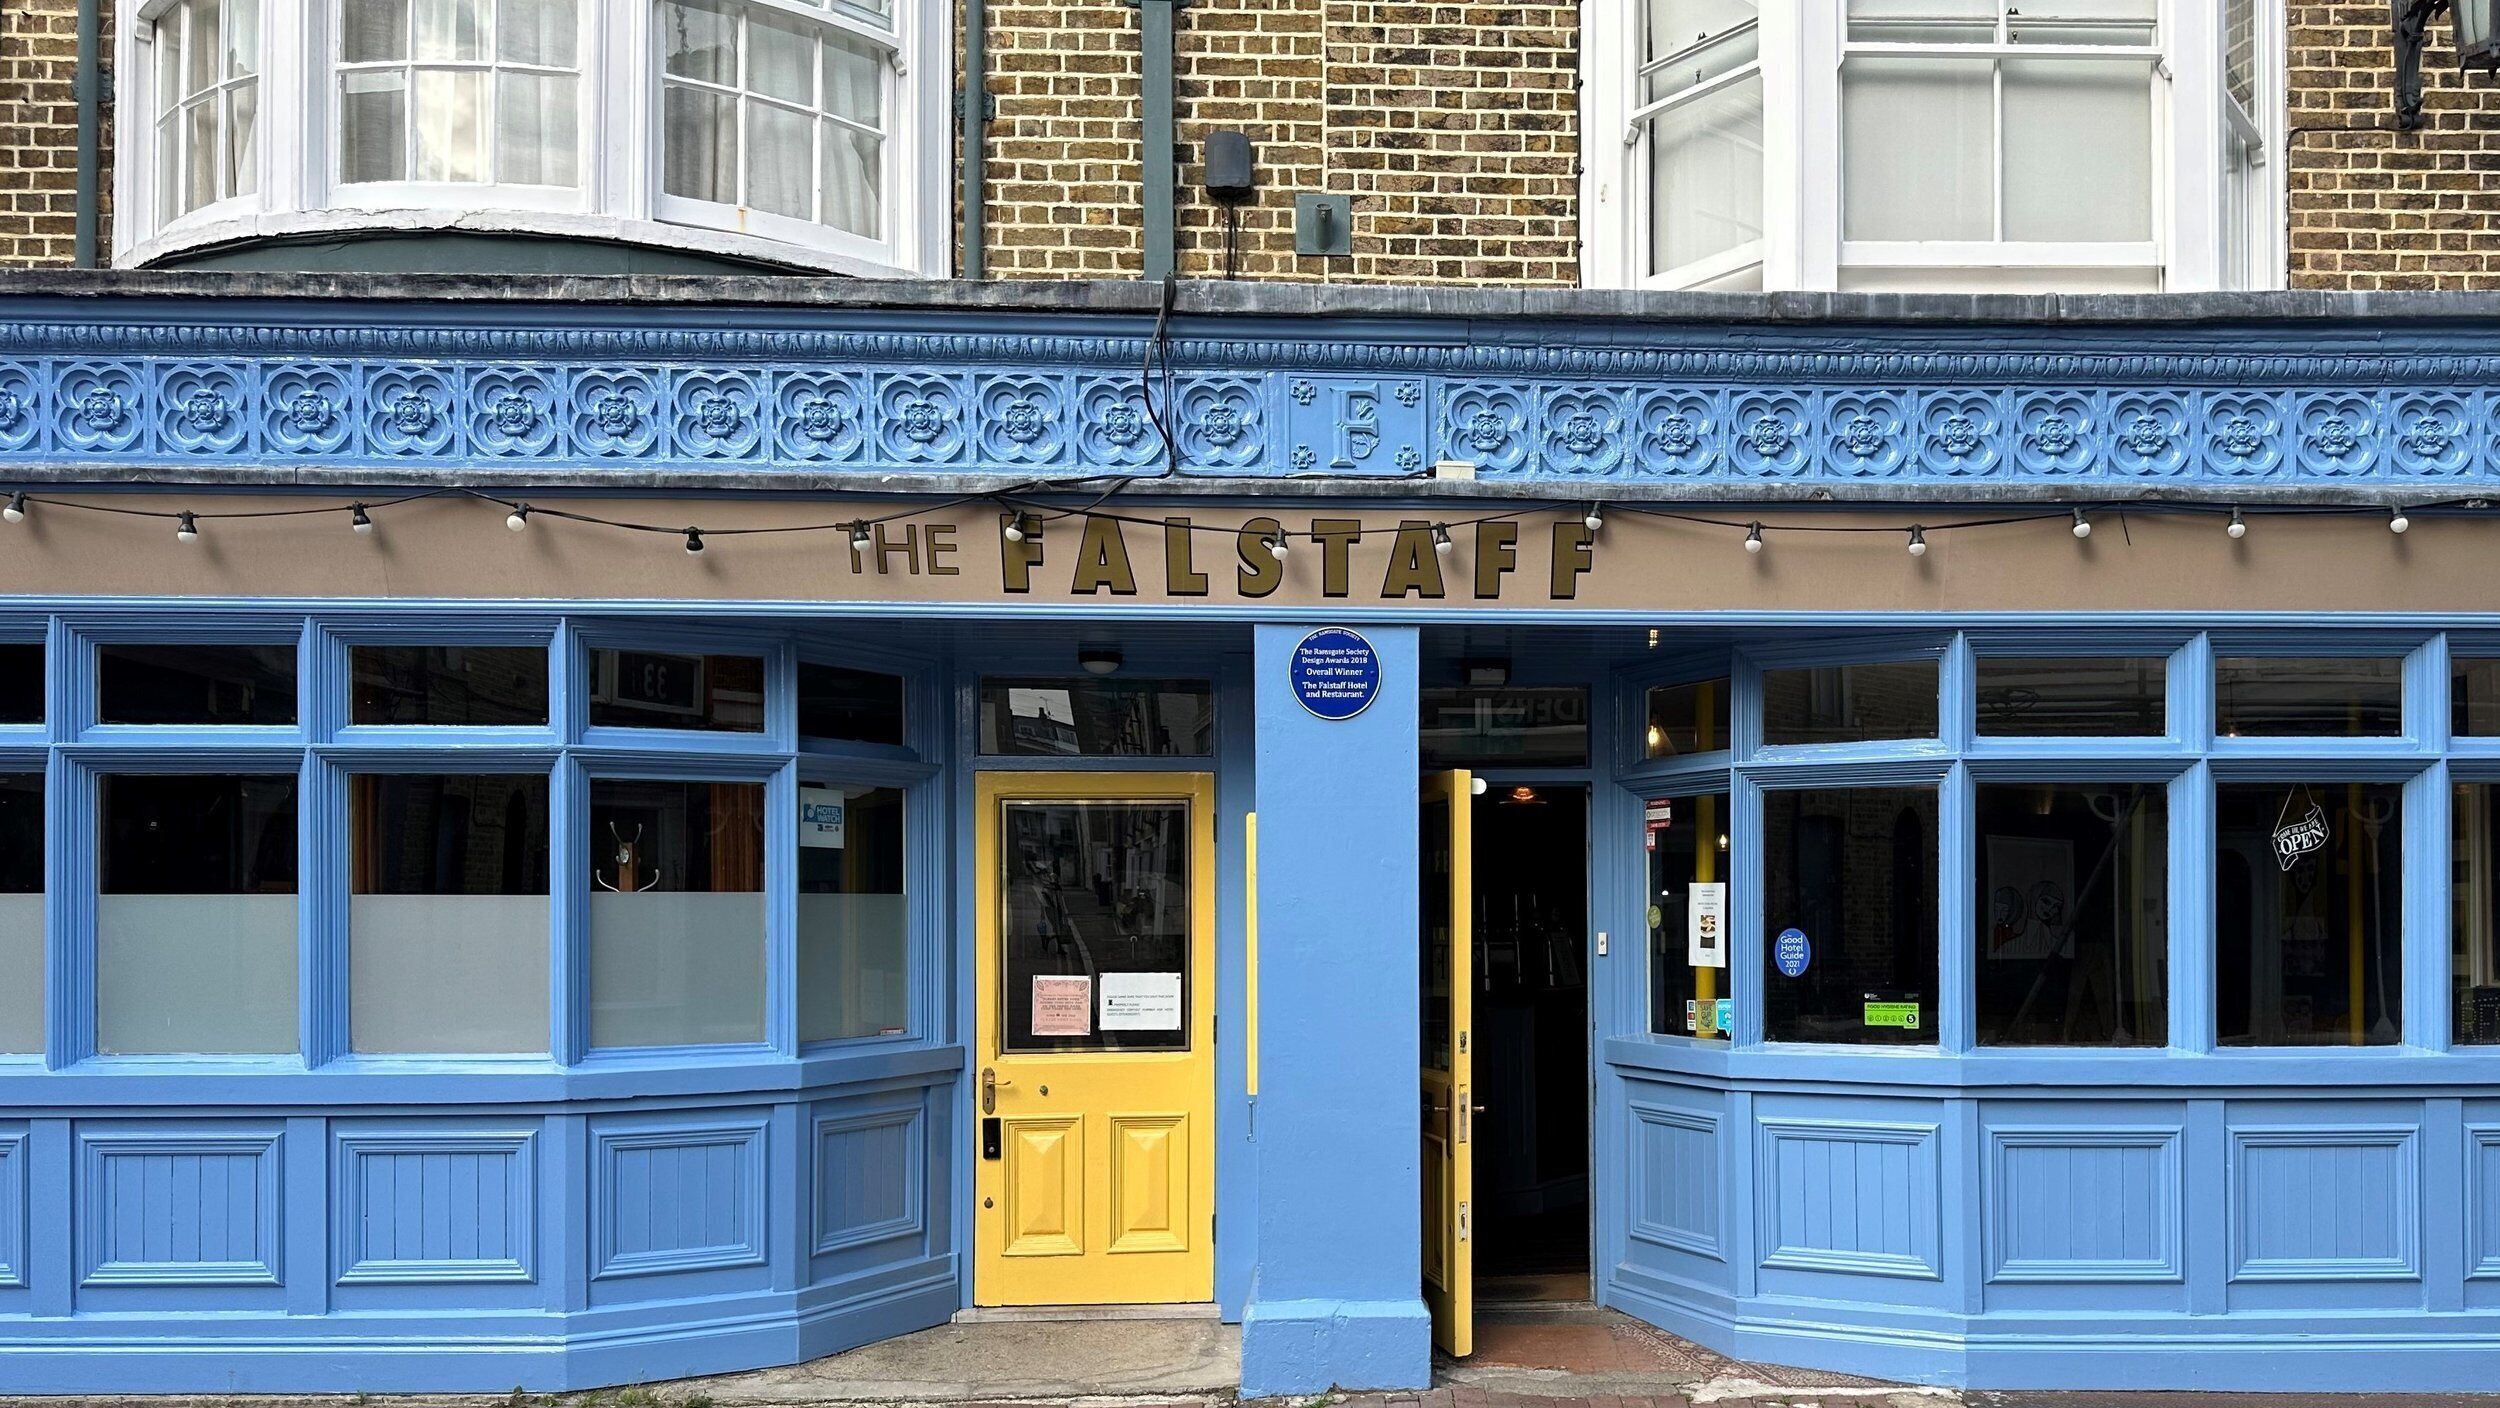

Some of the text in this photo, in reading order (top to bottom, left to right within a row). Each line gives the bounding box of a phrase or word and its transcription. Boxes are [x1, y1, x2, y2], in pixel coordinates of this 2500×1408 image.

[835, 514, 1594, 600] THE FALSTAFF
[1314, 648, 1345, 656] Ramsgate
[1346, 648, 1369, 656] Society
[1302, 657, 1324, 665] Design
[1306, 668, 1363, 676] Overall Winner
[1318, 681, 1347, 689] Falstaff
[1347, 681, 1368, 689] Hotel
[816, 806, 840, 815] HOTEL
[817, 814, 840, 823] WATCH
[2277, 830, 2291, 842] COME
[2308, 818, 2319, 829] ARE
[2280, 823, 2325, 855] OPEN
[1780, 935, 1803, 944] Good
[1781, 943, 1803, 951] Hotel
[1780, 951, 1804, 960] Guide
[1785, 960, 1800, 968] 2021
[2462, 1004, 2500, 1044] RE
